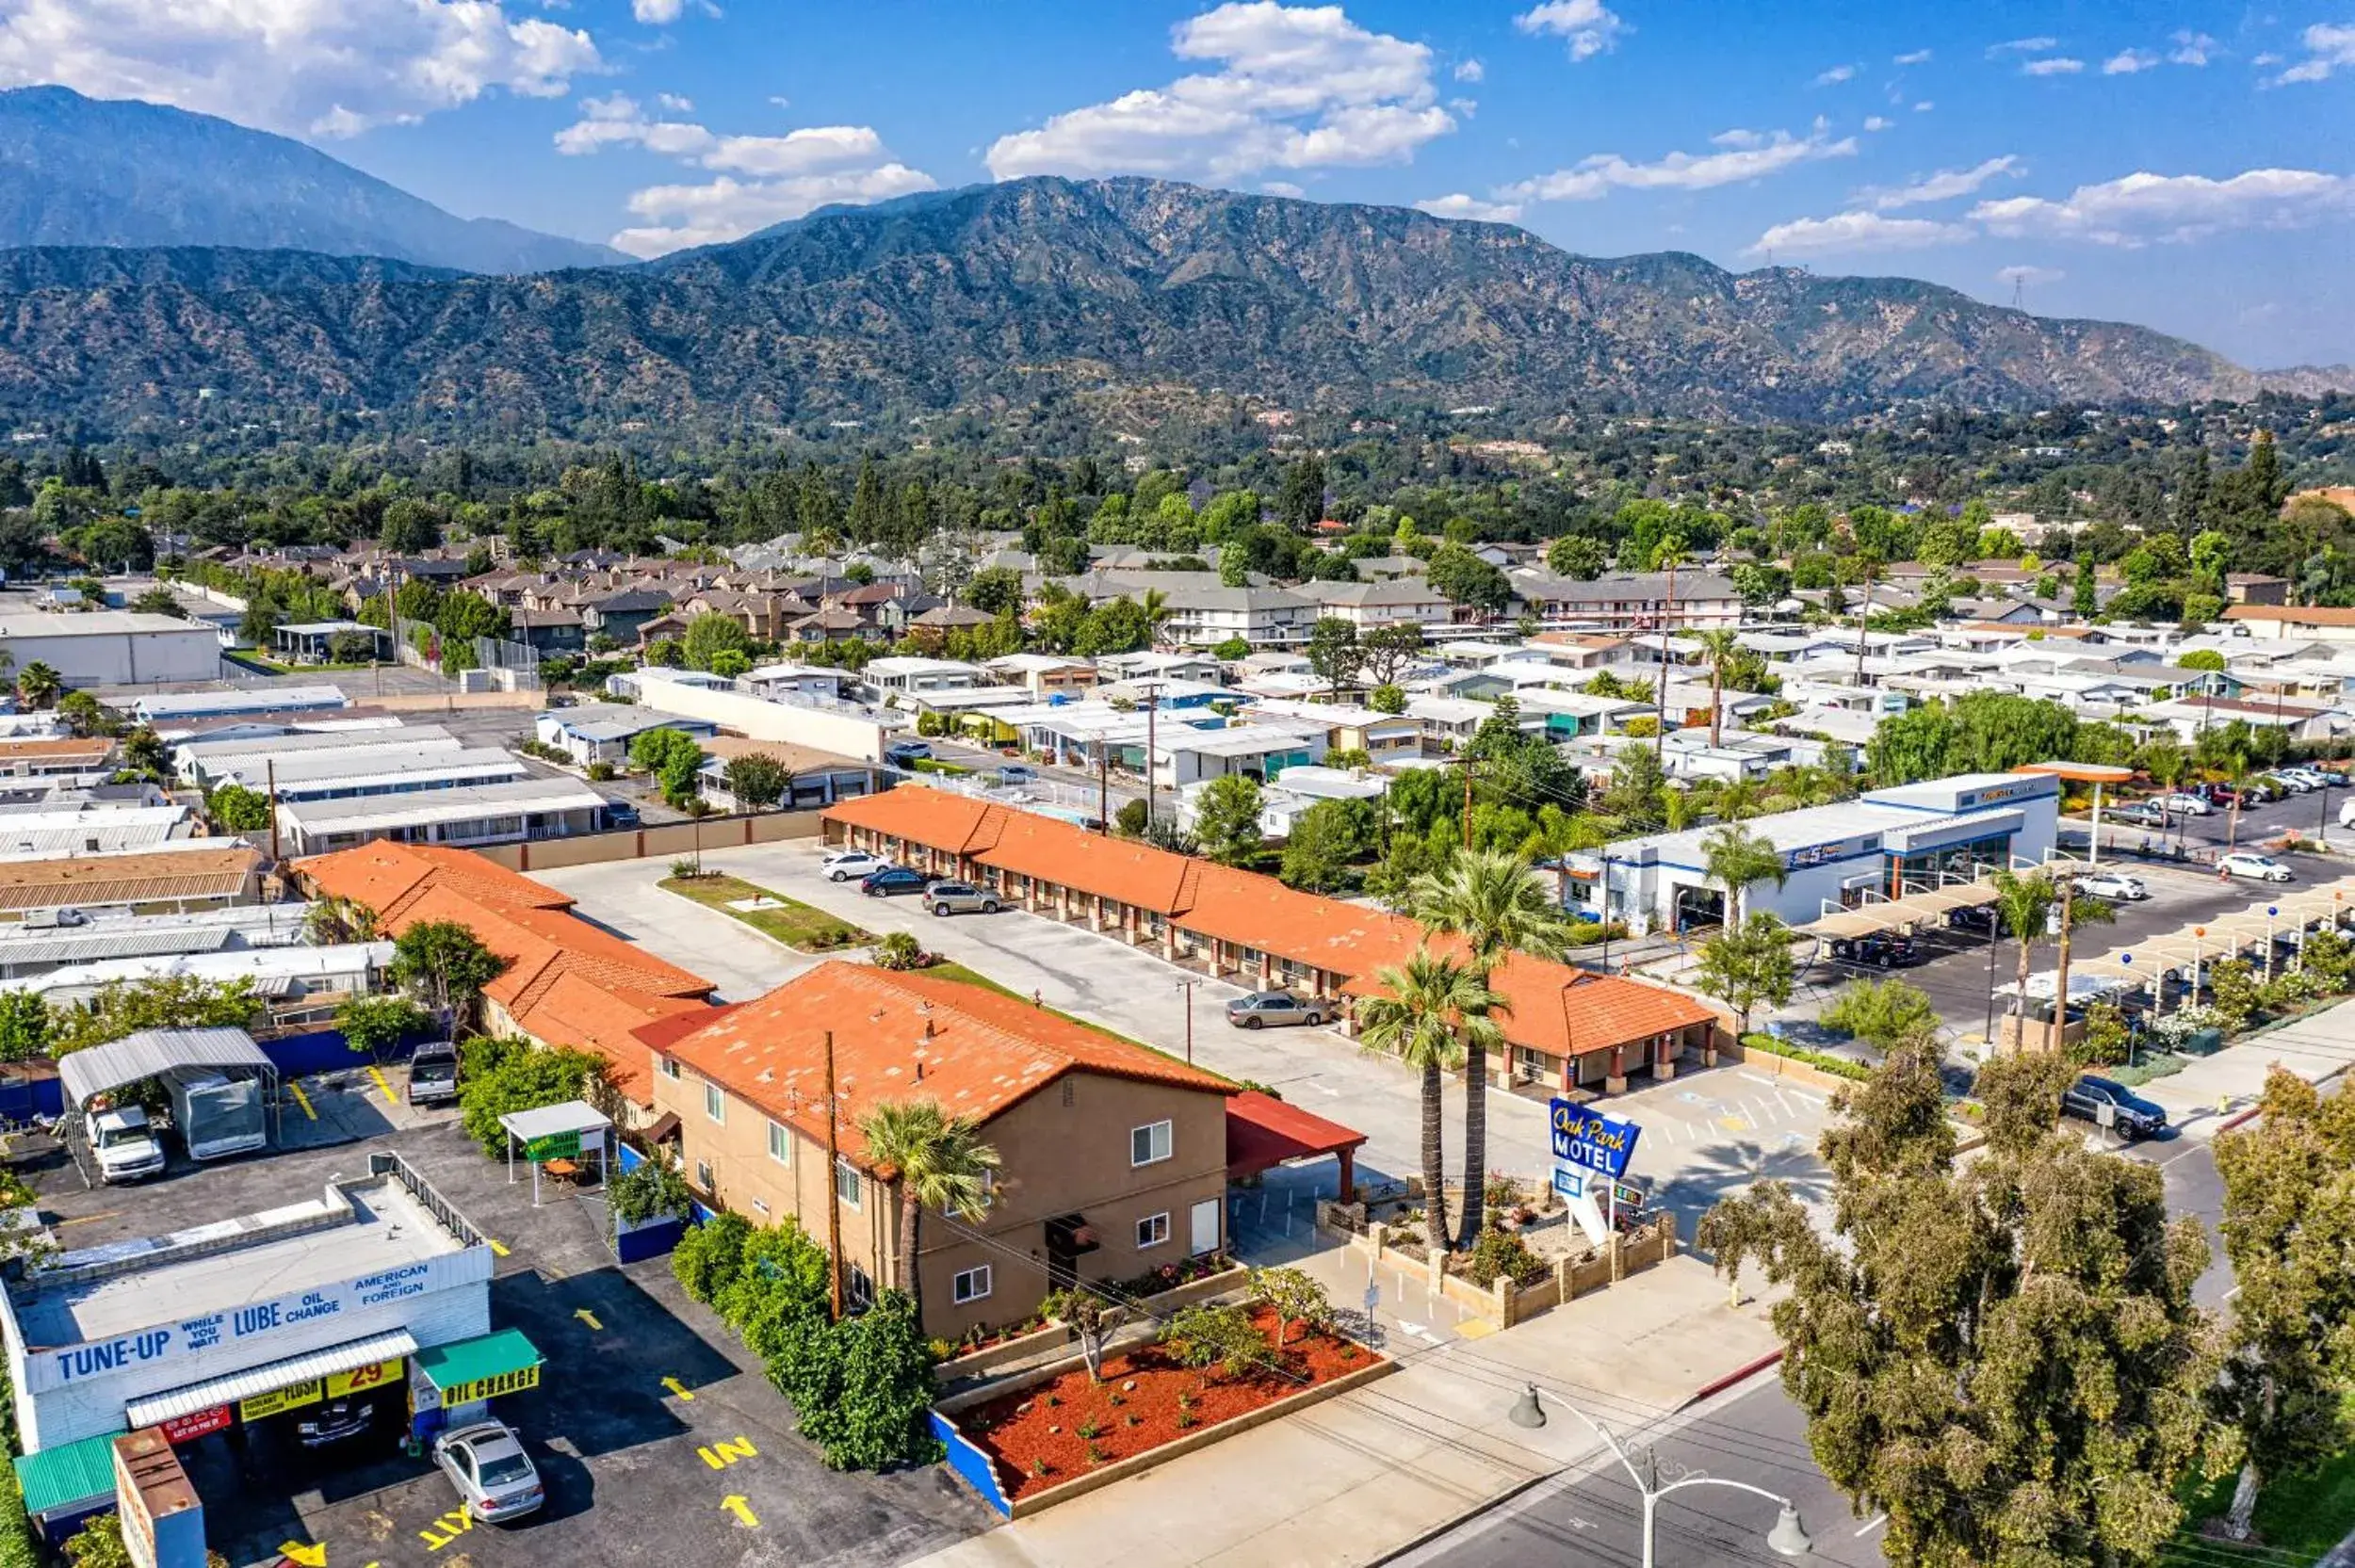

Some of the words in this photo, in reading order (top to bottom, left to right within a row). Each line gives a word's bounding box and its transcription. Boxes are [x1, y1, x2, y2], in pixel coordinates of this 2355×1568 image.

[1553, 1107, 1584, 1137] Oak
[1587, 1120, 1625, 1152] Park
[1555, 1132, 1616, 1173] MOTEL
[354, 1264, 429, 1291] AMERICAN
[382, 1280, 402, 1290] AND
[301, 1292, 325, 1306] OIL
[362, 1282, 424, 1305] FOREIGN
[182, 1315, 224, 1333] WHILE
[235, 1302, 281, 1336] LUBE
[285, 1301, 340, 1323] CHANGE
[187, 1335, 221, 1350] WAIT
[191, 1328, 217, 1340] YOU
[57, 1331, 171, 1380] TUNE-UP
[447, 1384, 470, 1404] OIL
[476, 1367, 535, 1398] CHANGE
[697, 1437, 757, 1470] IN
[419, 1505, 473, 1551] XIT
